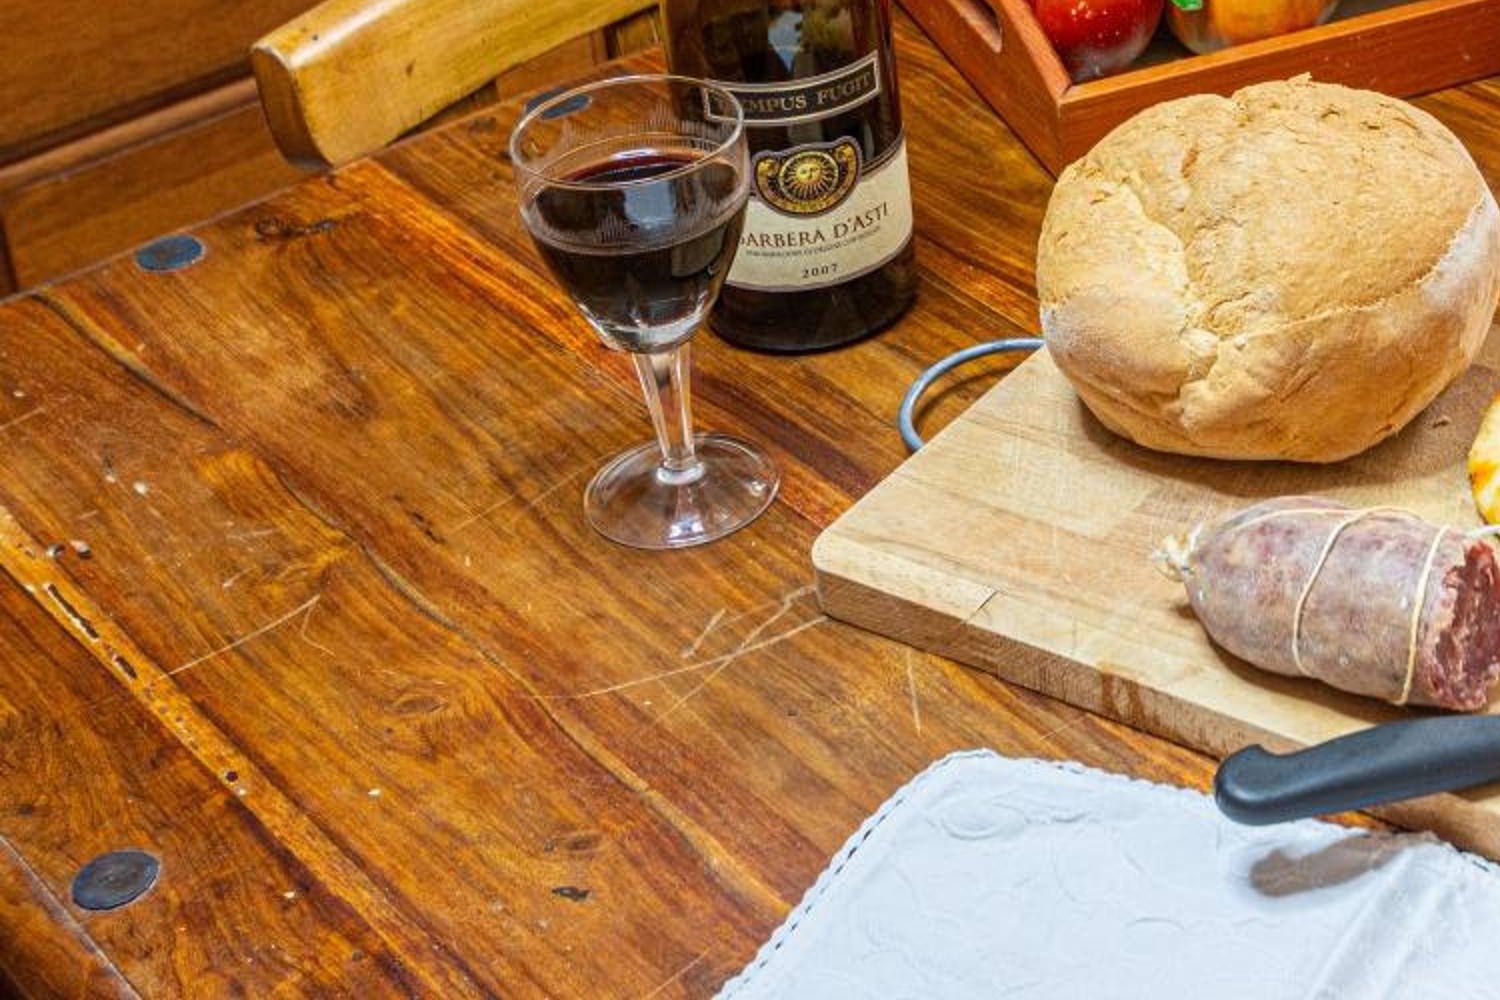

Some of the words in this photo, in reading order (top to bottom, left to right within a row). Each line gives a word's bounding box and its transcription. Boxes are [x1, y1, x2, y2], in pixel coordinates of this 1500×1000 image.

[816, 71, 871, 106] FUGIT
[833, 201, 889, 239] D'ASTI
[802, 263, 839, 280] 2007
